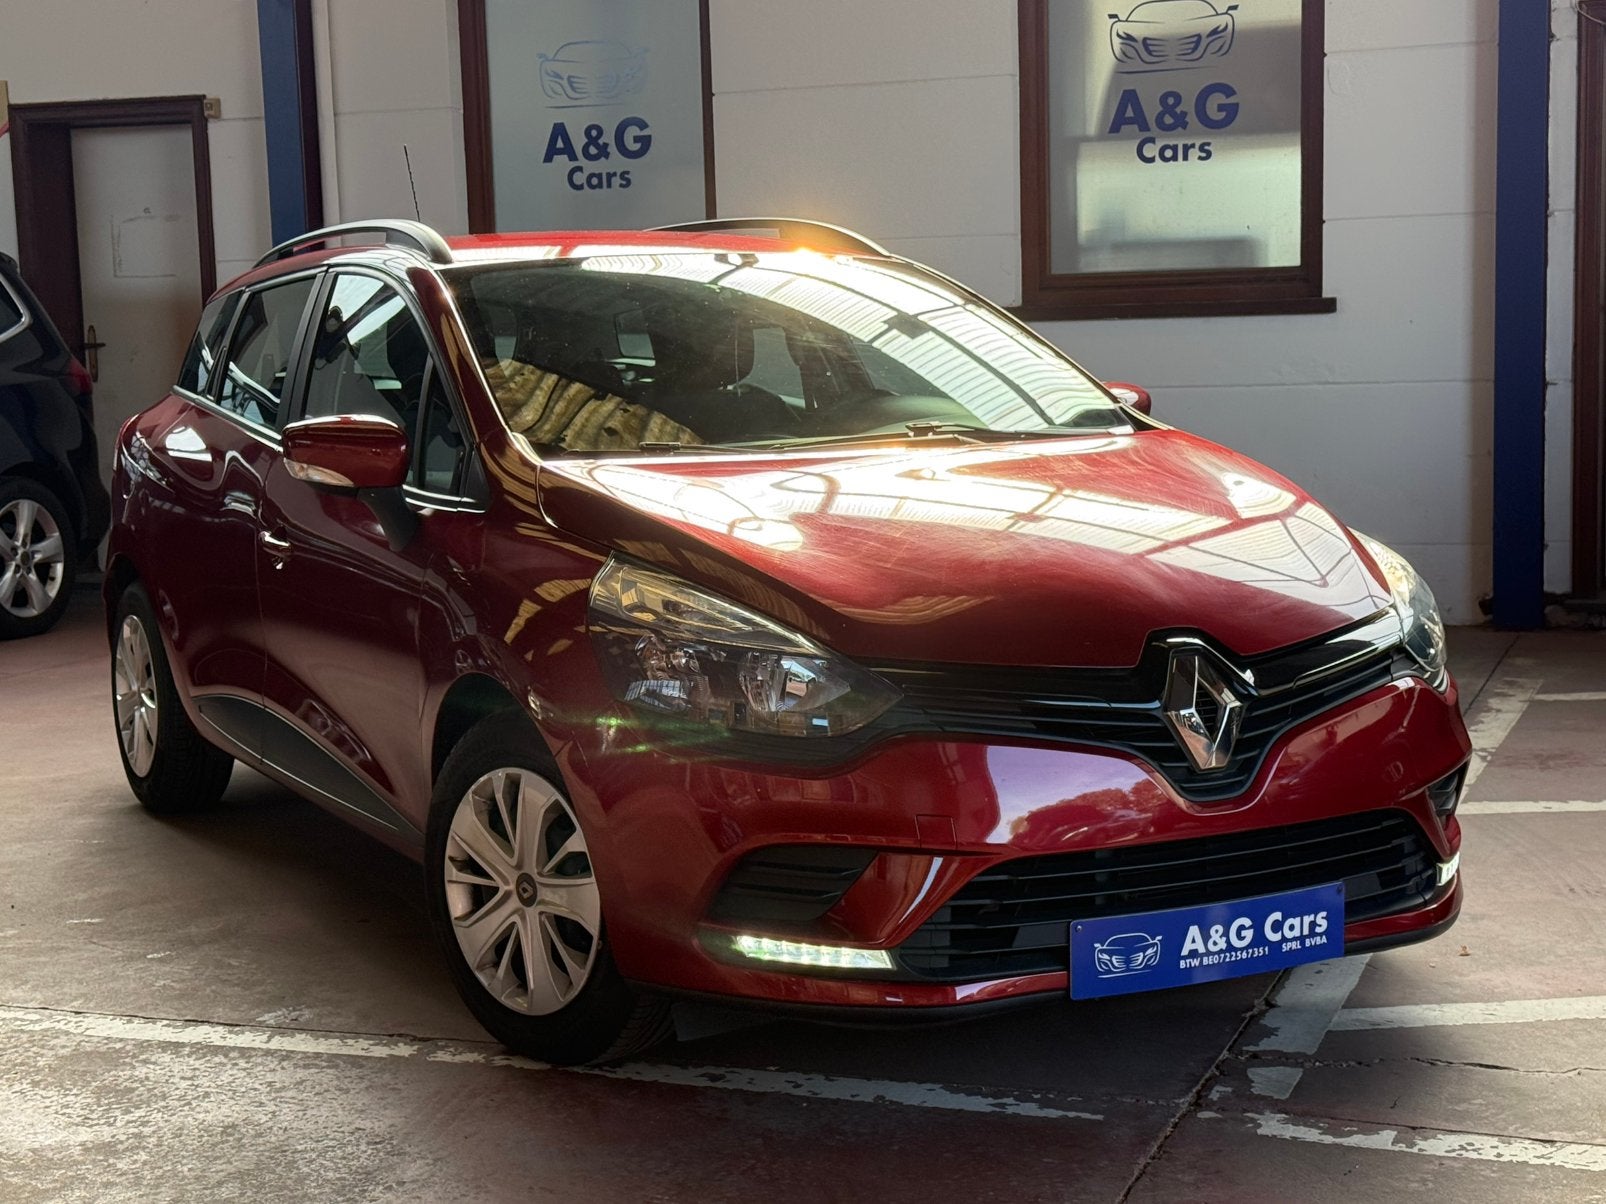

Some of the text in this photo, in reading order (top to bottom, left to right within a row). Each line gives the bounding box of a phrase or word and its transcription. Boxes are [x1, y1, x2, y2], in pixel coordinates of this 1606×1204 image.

[1108, 82, 1240, 134] A&G
[542, 116, 652, 163] A&G
[1136, 136, 1212, 164] Cars
[567, 165, 632, 191] Cars
[1179, 935, 1328, 969] BTW BE0722567351 SPRL BVBA
[1180, 911, 1328, 956] A&G Cars
